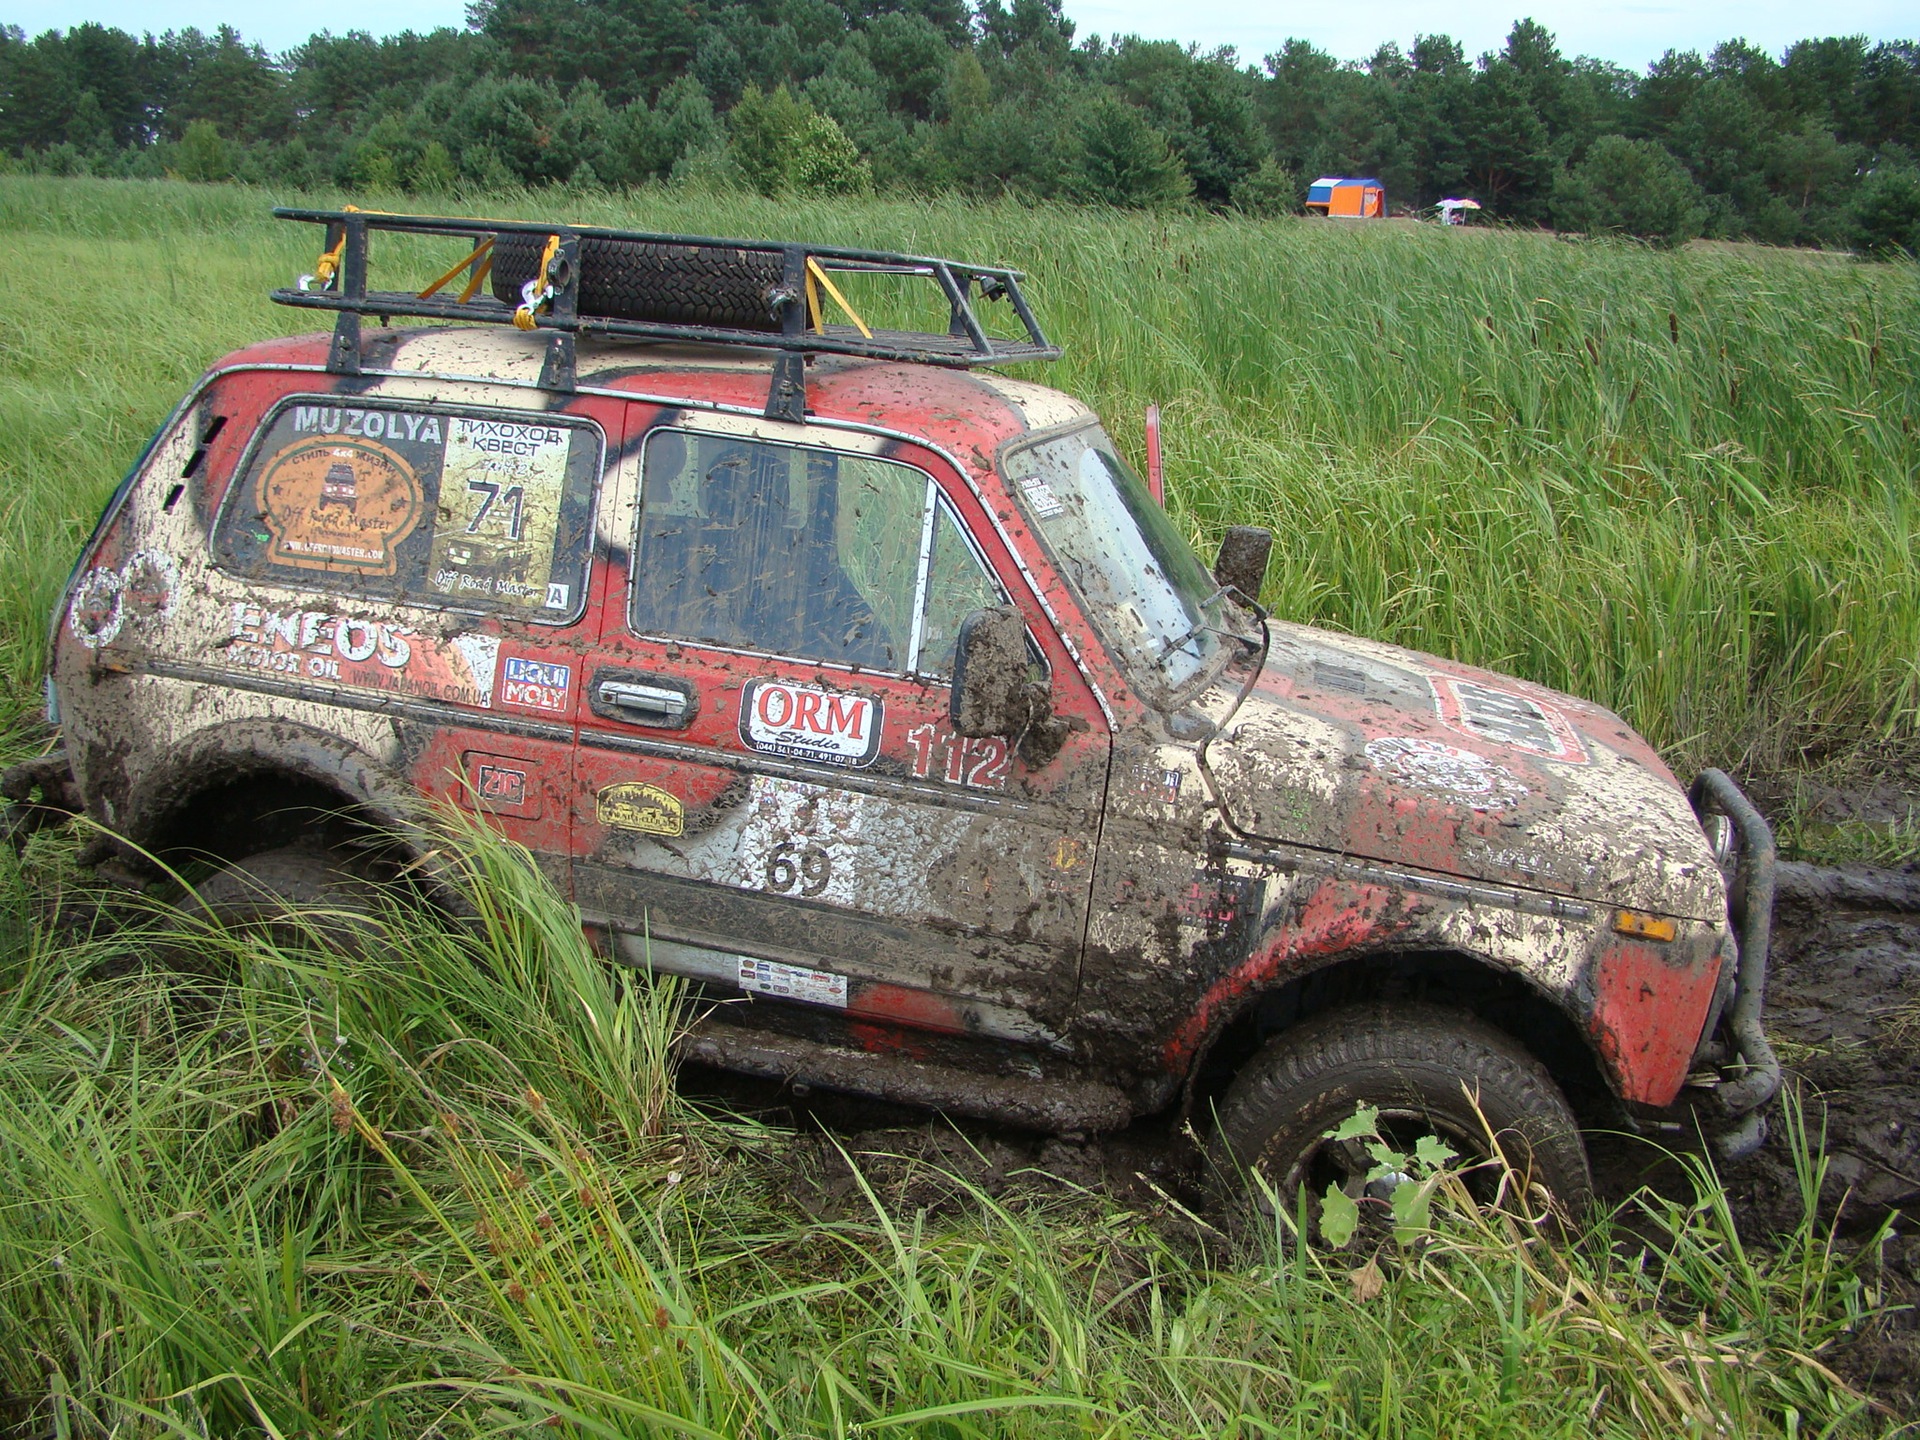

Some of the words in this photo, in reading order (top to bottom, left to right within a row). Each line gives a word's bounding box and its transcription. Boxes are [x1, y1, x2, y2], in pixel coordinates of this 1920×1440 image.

[295, 406, 442, 444] MUZOLYA
[459, 419, 562, 446] ТИХОХОД
[292, 449, 330, 465] СТИЛЬ
[473, 437, 541, 457] КВЕСТ
[467, 479, 525, 541] 71
[549, 588, 563, 604] A
[231, 602, 411, 668] ENEOS
[228, 643, 301, 674] MOTOR
[308, 656, 343, 680] OIL
[507, 657, 566, 688] LIQUI
[506, 681, 566, 708] MOLY
[758, 687, 868, 740] ORM
[756, 741, 776, 753] (044)
[774, 731, 841, 750] Studio
[907, 723, 1008, 792] 112
[766, 842, 832, 897] 69
